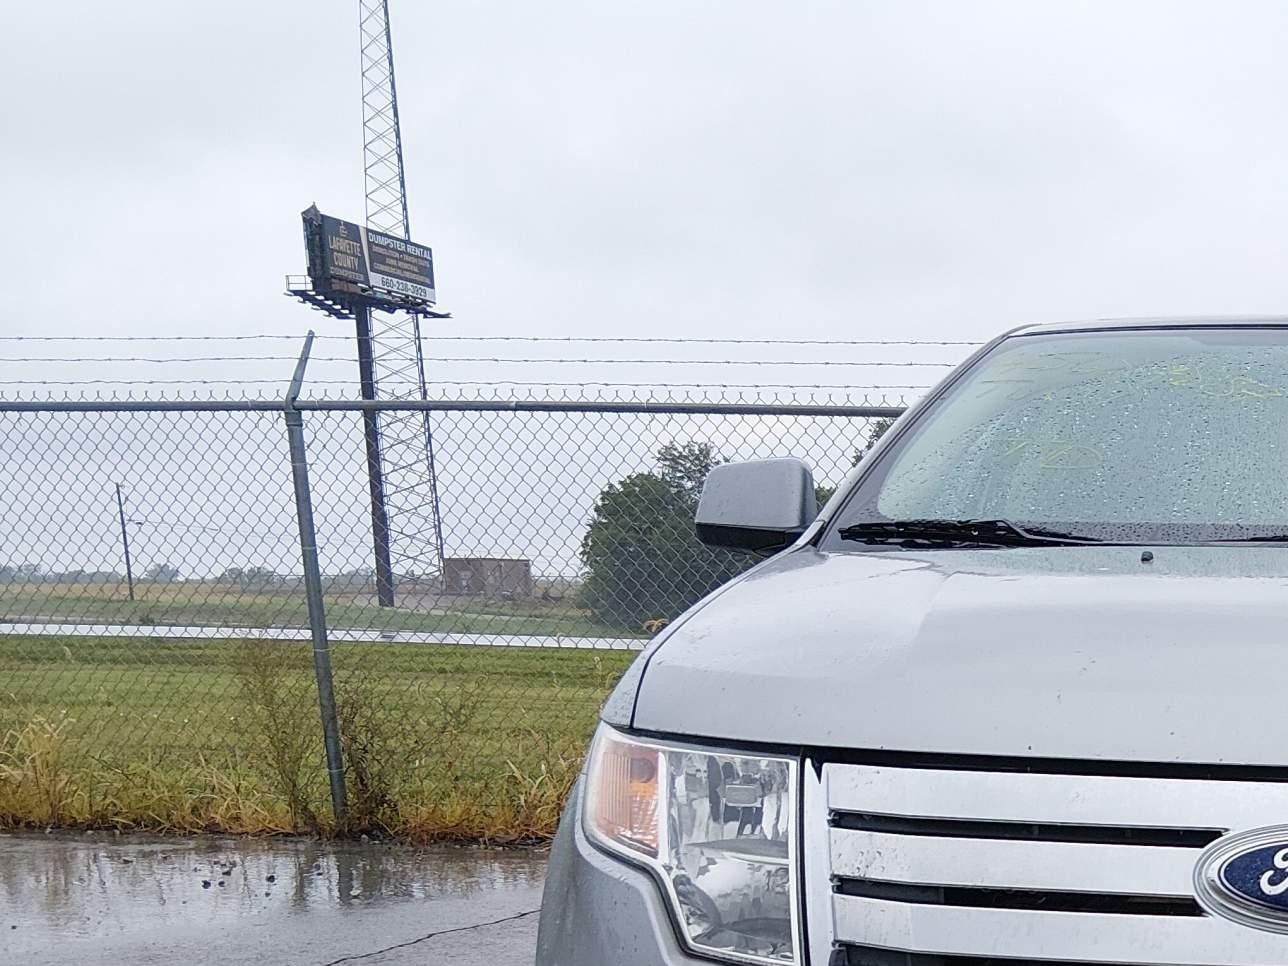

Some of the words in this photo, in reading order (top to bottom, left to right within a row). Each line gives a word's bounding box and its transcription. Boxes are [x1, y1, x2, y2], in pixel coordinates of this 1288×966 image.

[368, 232, 406, 251] DUMPSTER
[406, 244, 431, 260] RENTAL
[333, 252, 359, 272] COUNTY
